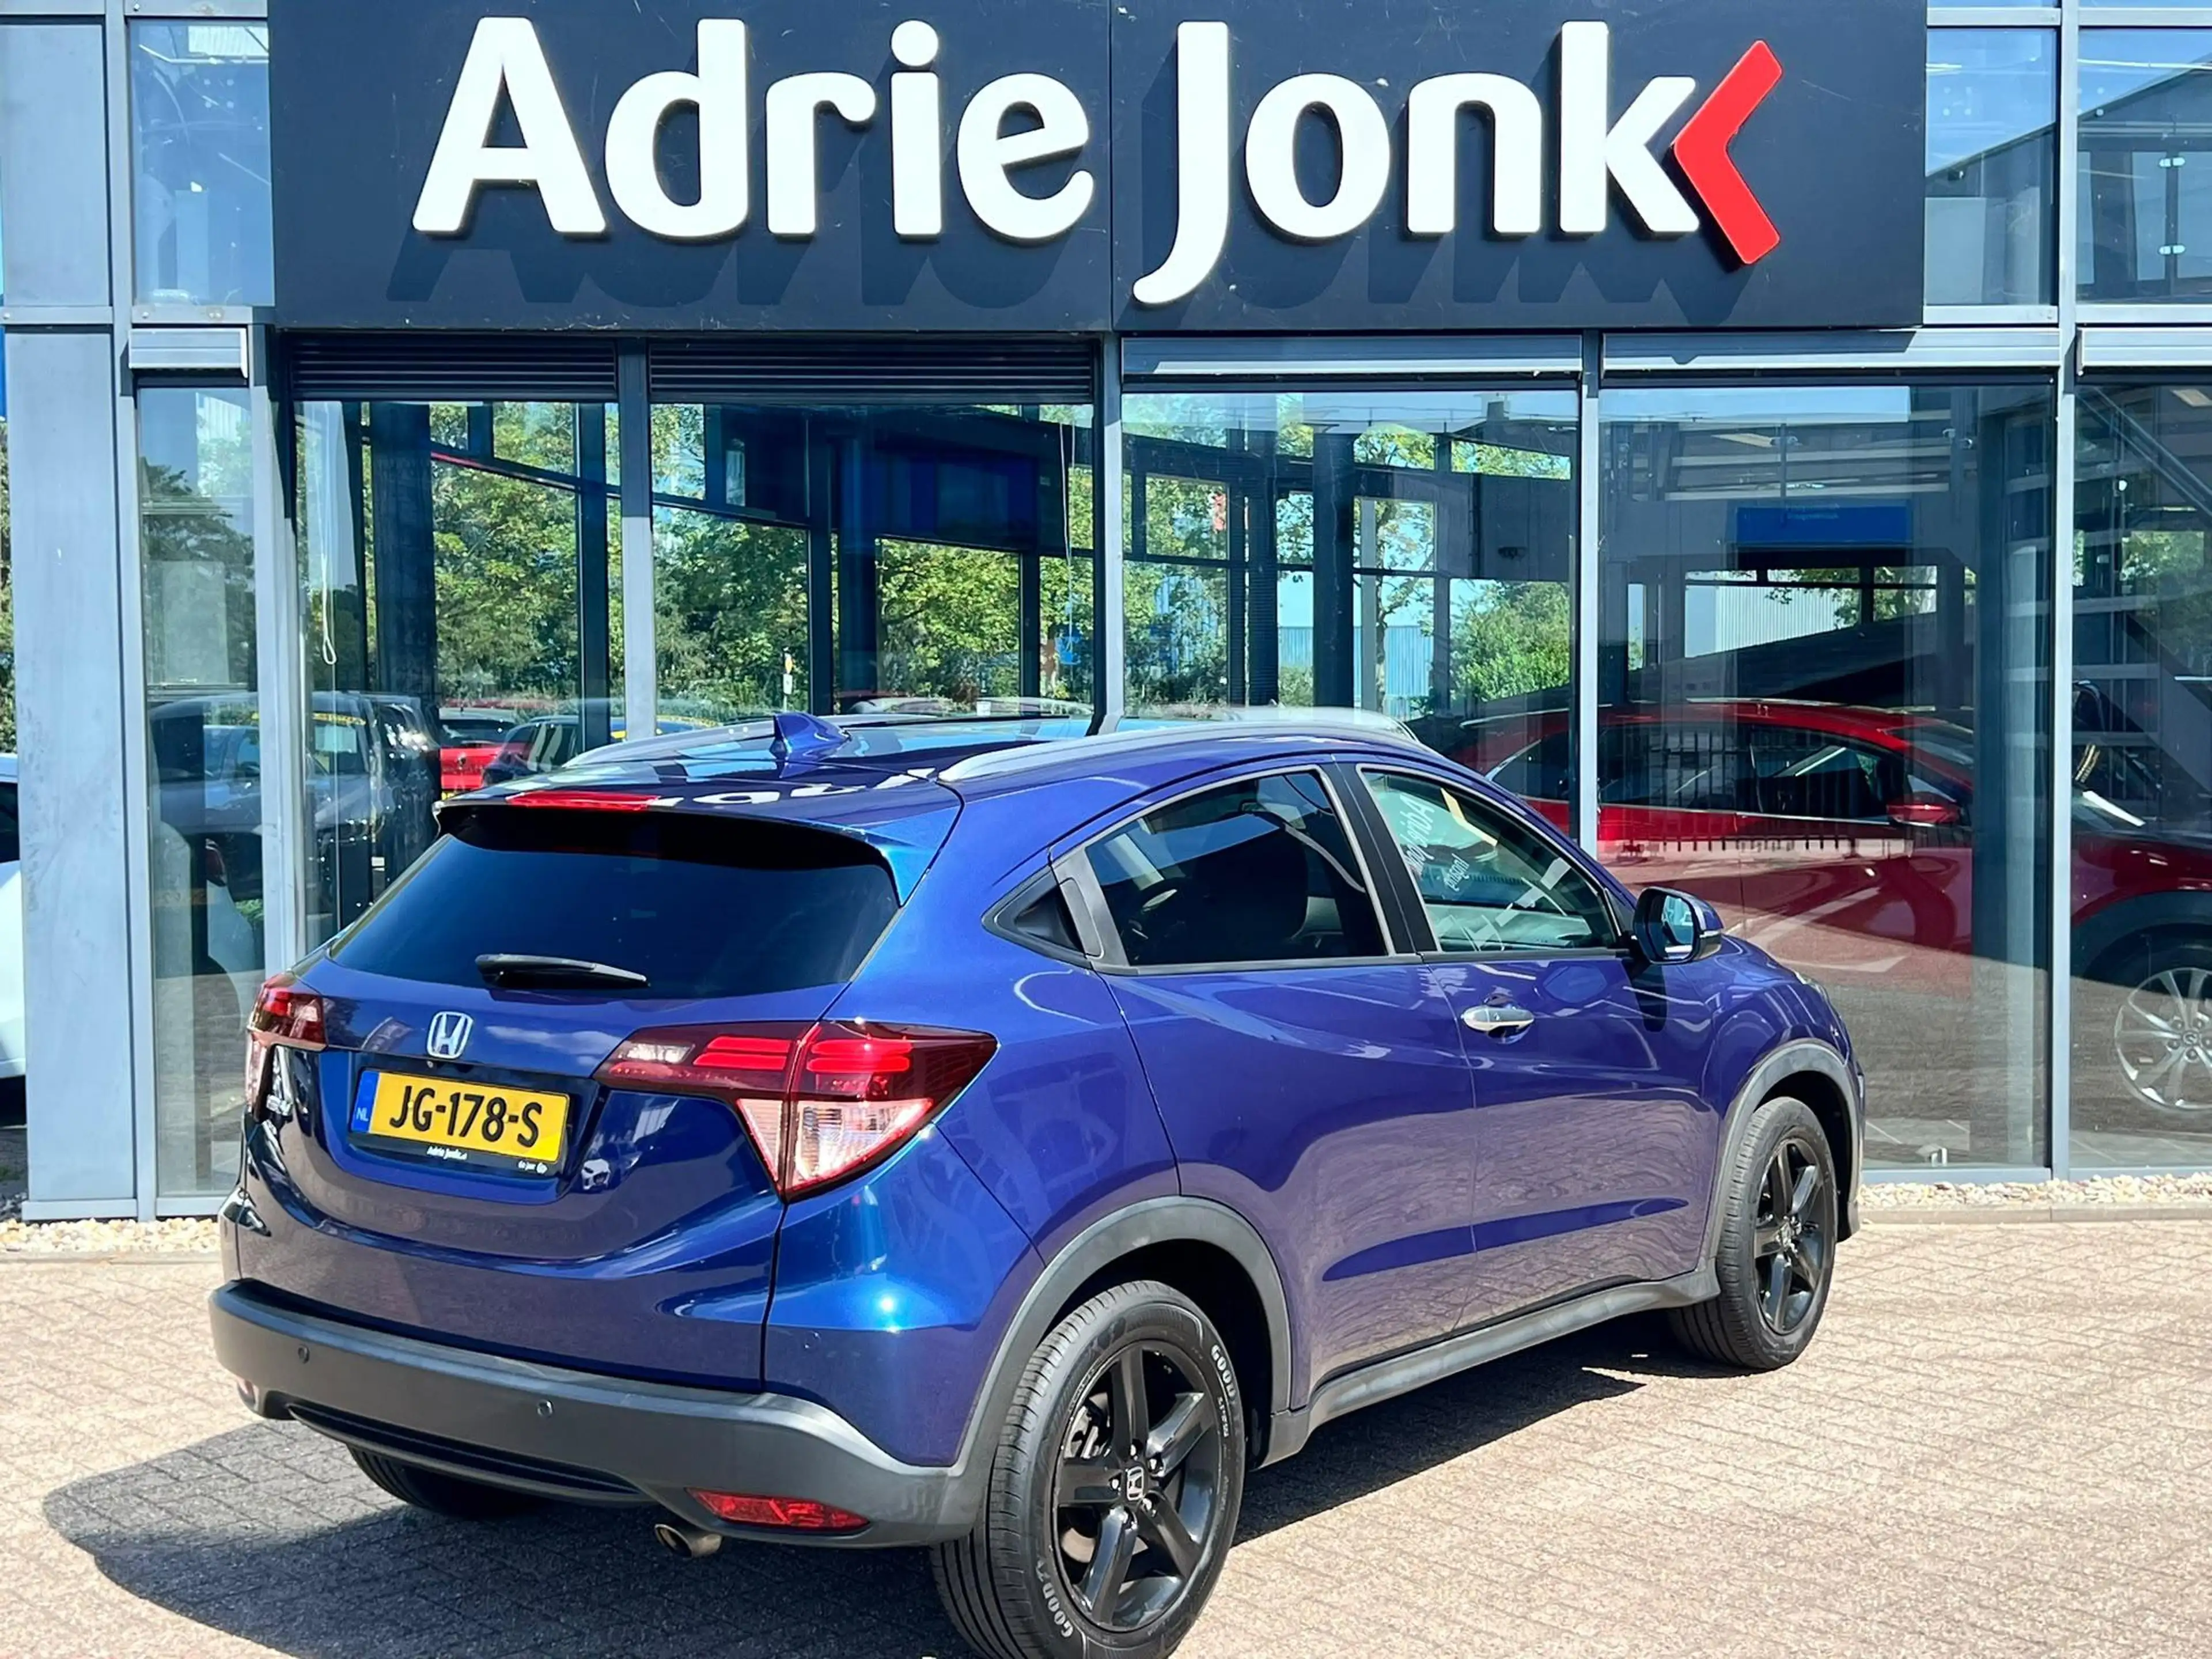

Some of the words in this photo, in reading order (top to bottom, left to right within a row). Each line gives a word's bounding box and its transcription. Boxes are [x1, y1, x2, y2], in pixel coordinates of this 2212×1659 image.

[411, 16, 1094, 240] Adrie
[1132, 21, 1700, 304] Jonk
[356, 1107, 369, 1122] NL
[389, 1085, 543, 1148] JG-178-S
